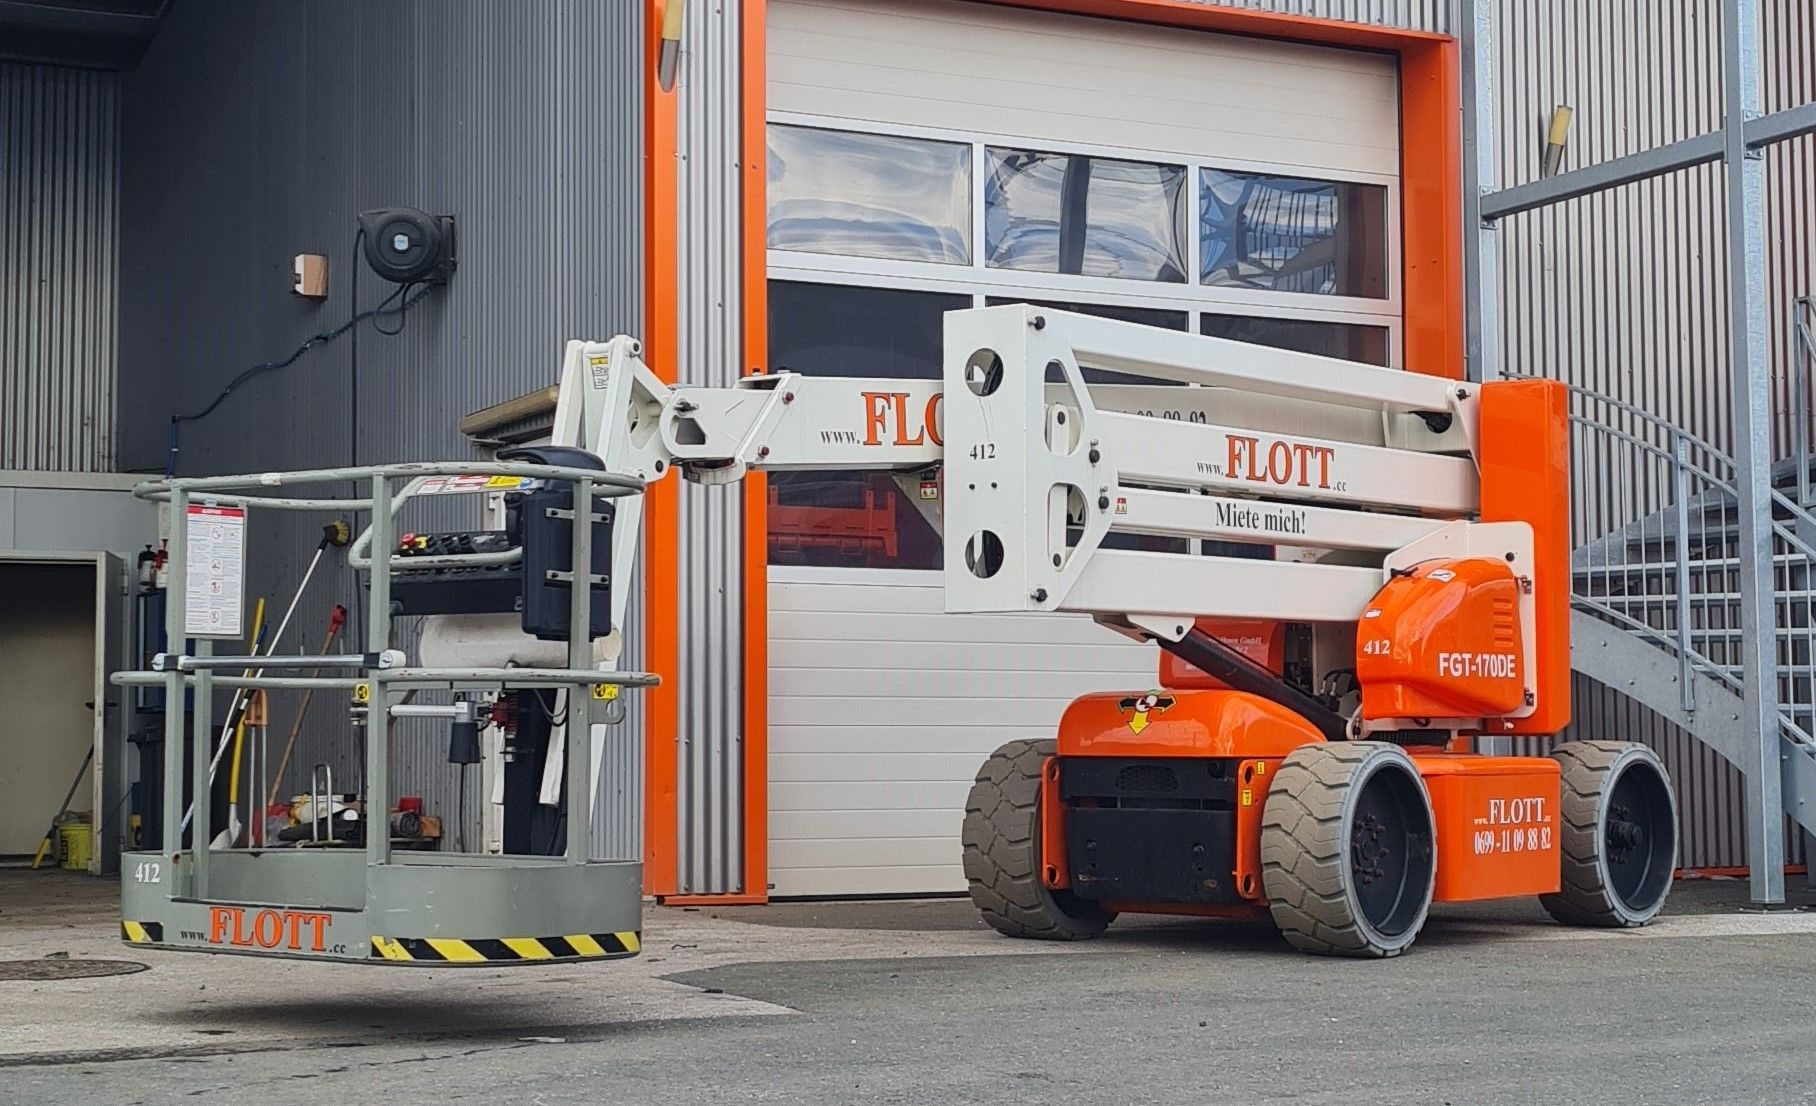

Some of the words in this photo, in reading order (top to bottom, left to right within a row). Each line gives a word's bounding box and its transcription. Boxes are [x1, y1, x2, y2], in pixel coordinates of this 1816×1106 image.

[969, 443, 996, 460] 412
[1215, 502, 1260, 530] Miete
[1264, 508, 1306, 535] mich!
[1363, 639, 1391, 655] 412
[1438, 652, 1516, 678] FGT-170DE
[1513, 828, 1525, 852] 09
[1527, 827, 1539, 851] 88
[1540, 826, 1552, 850] 82
[134, 862, 161, 883] 412
